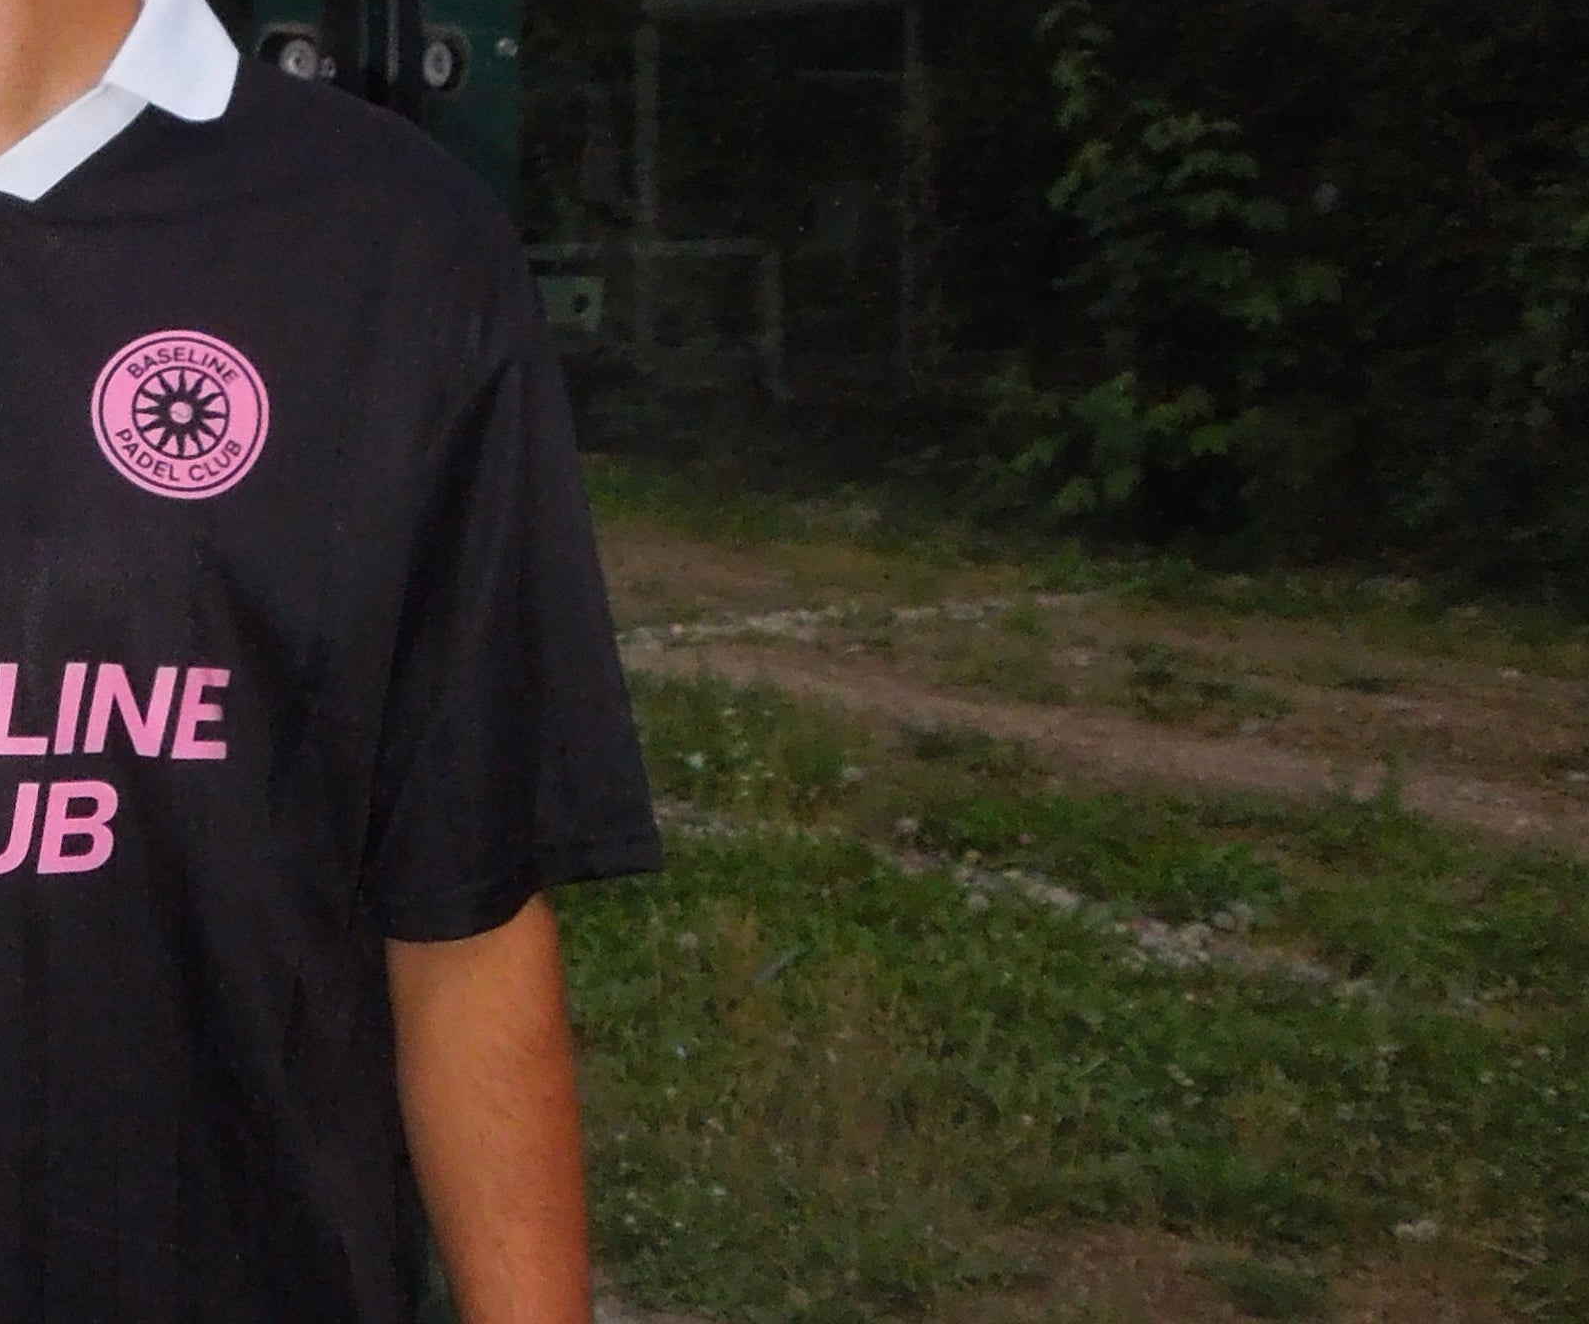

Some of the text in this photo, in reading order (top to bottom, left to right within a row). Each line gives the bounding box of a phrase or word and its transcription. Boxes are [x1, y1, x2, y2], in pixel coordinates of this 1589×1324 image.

[126, 345, 240, 385] BASELINE
[115, 427, 243, 483] PADEL CLUB
